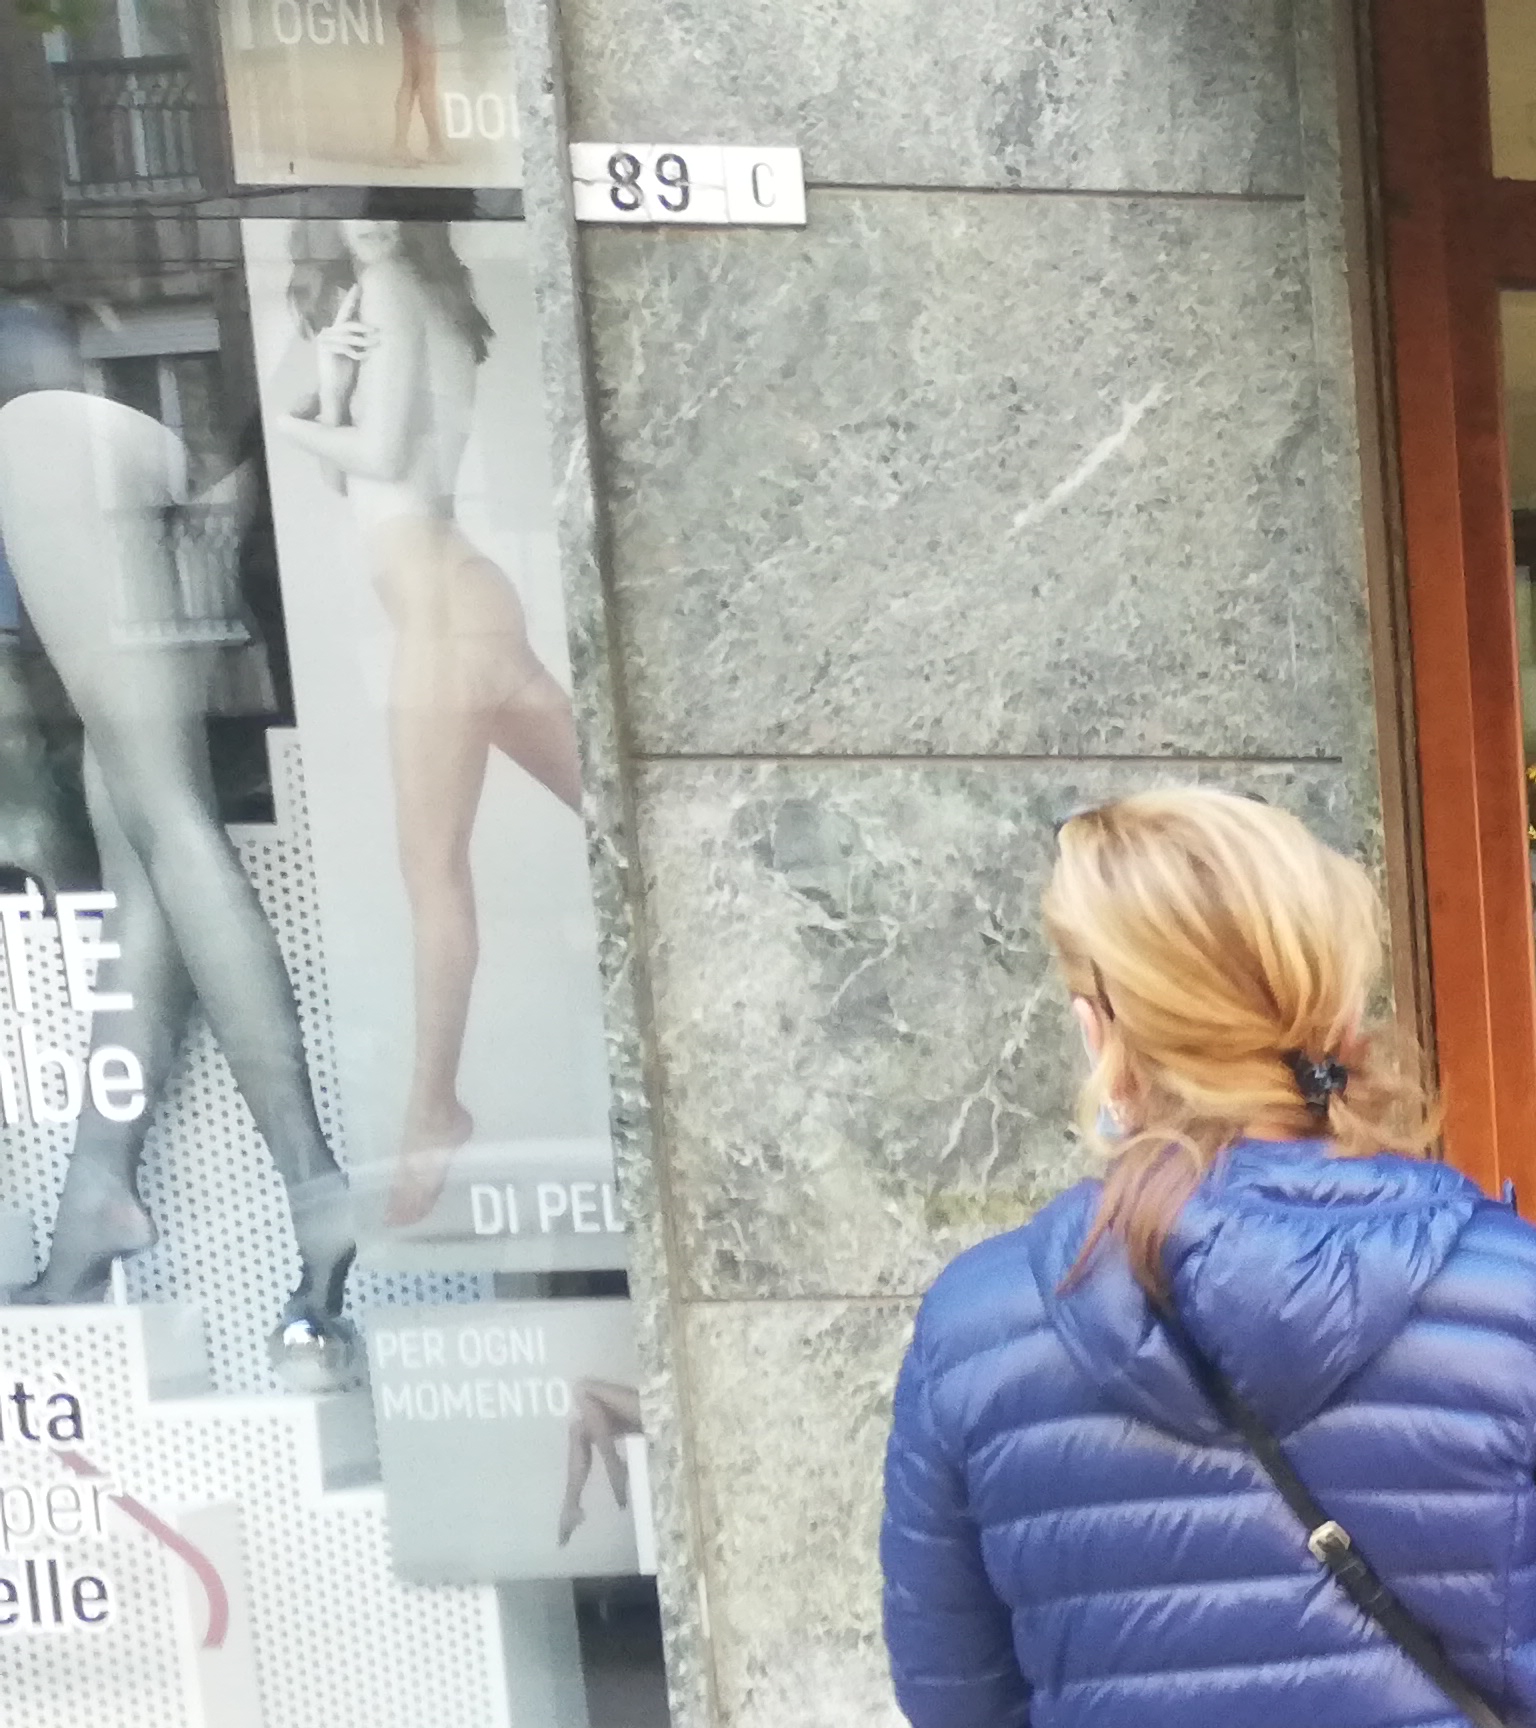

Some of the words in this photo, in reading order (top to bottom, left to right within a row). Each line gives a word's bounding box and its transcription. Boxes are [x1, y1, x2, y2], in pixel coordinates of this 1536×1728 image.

[272, 0, 385, 46] OGNI
[606, 151, 691, 212] 89
[0, 1024, 147, 1124] be
[470, 1182, 520, 1235] DI
[374, 1327, 445, 1370] PER
[456, 1325, 549, 1367] OGNI
[0, 1372, 85, 1443] tà
[380, 1376, 571, 1421] MOMENTO
